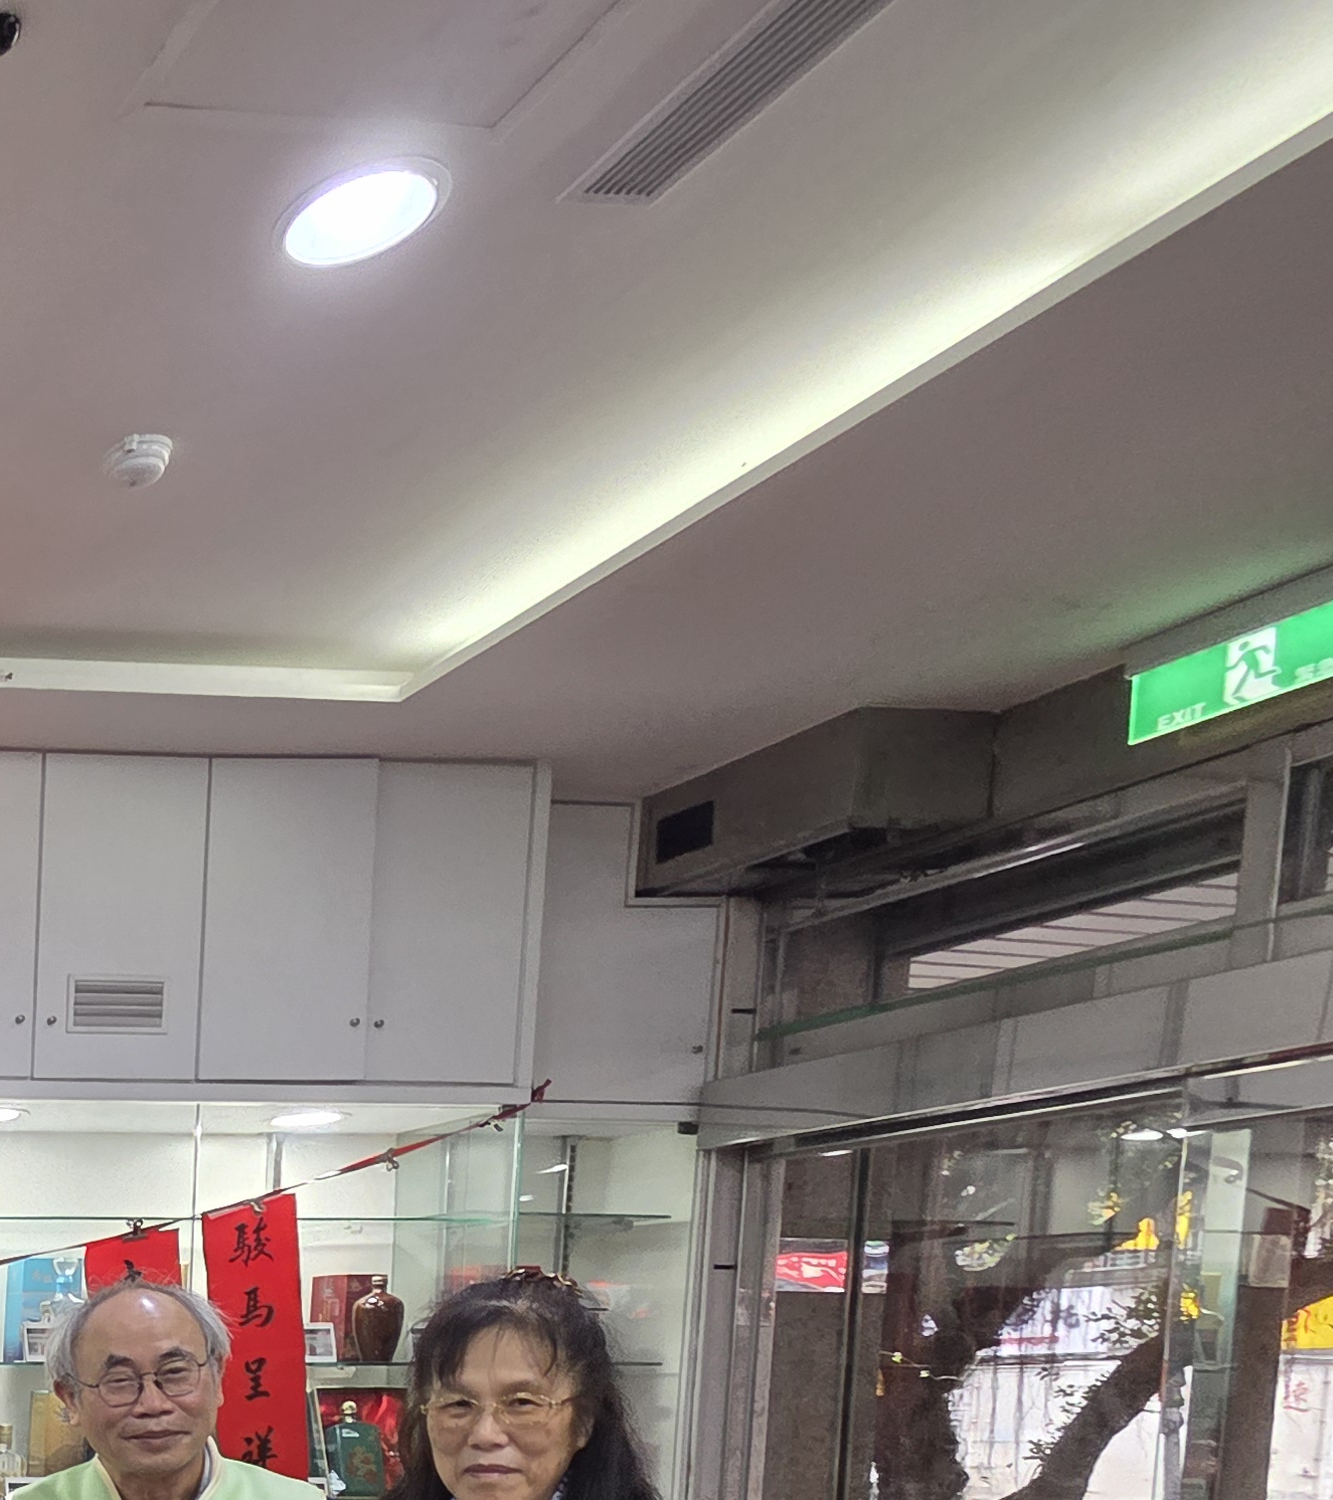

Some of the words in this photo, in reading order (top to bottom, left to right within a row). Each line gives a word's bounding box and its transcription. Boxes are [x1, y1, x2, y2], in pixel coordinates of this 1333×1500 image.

[1157, 702, 1206, 732] EXIT
[229, 1217, 278, 1468] 駿馬呈祥
